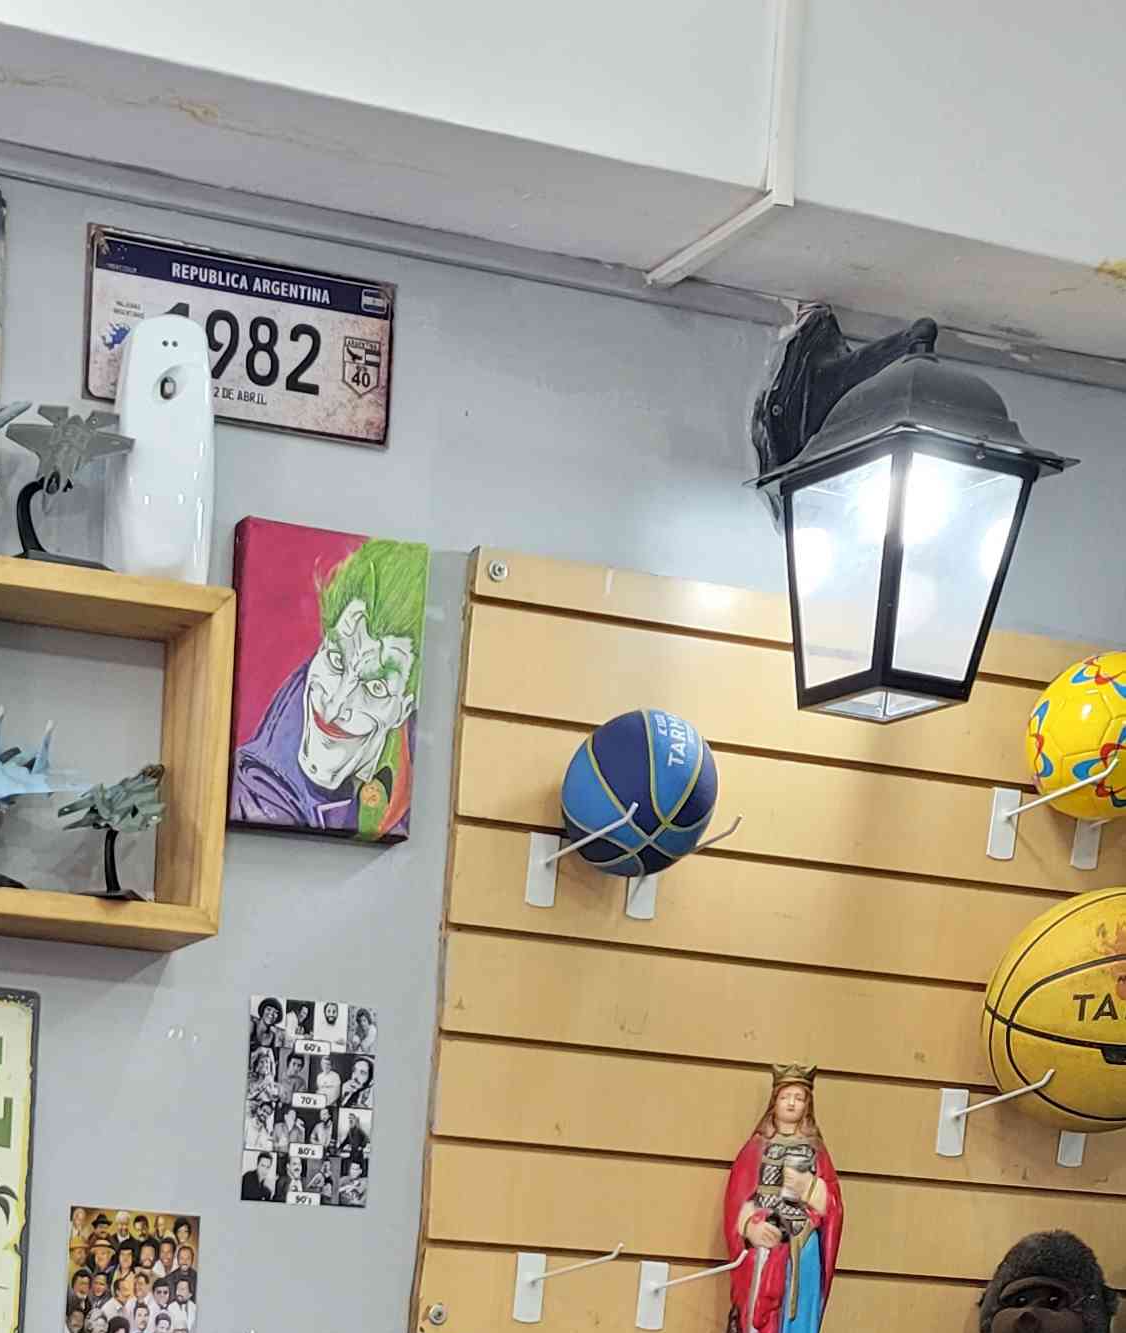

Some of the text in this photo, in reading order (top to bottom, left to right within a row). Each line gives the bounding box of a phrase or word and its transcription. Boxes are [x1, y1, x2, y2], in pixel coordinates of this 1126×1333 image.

[171, 262, 331, 305] REPUBLICA ARGENTINA
[166, 302, 321, 396] 982
[213, 388, 220, 397] 2
[221, 388, 235, 400] DE
[351, 371, 371, 388] 40
[1073, 993, 1126, 1022] TA
